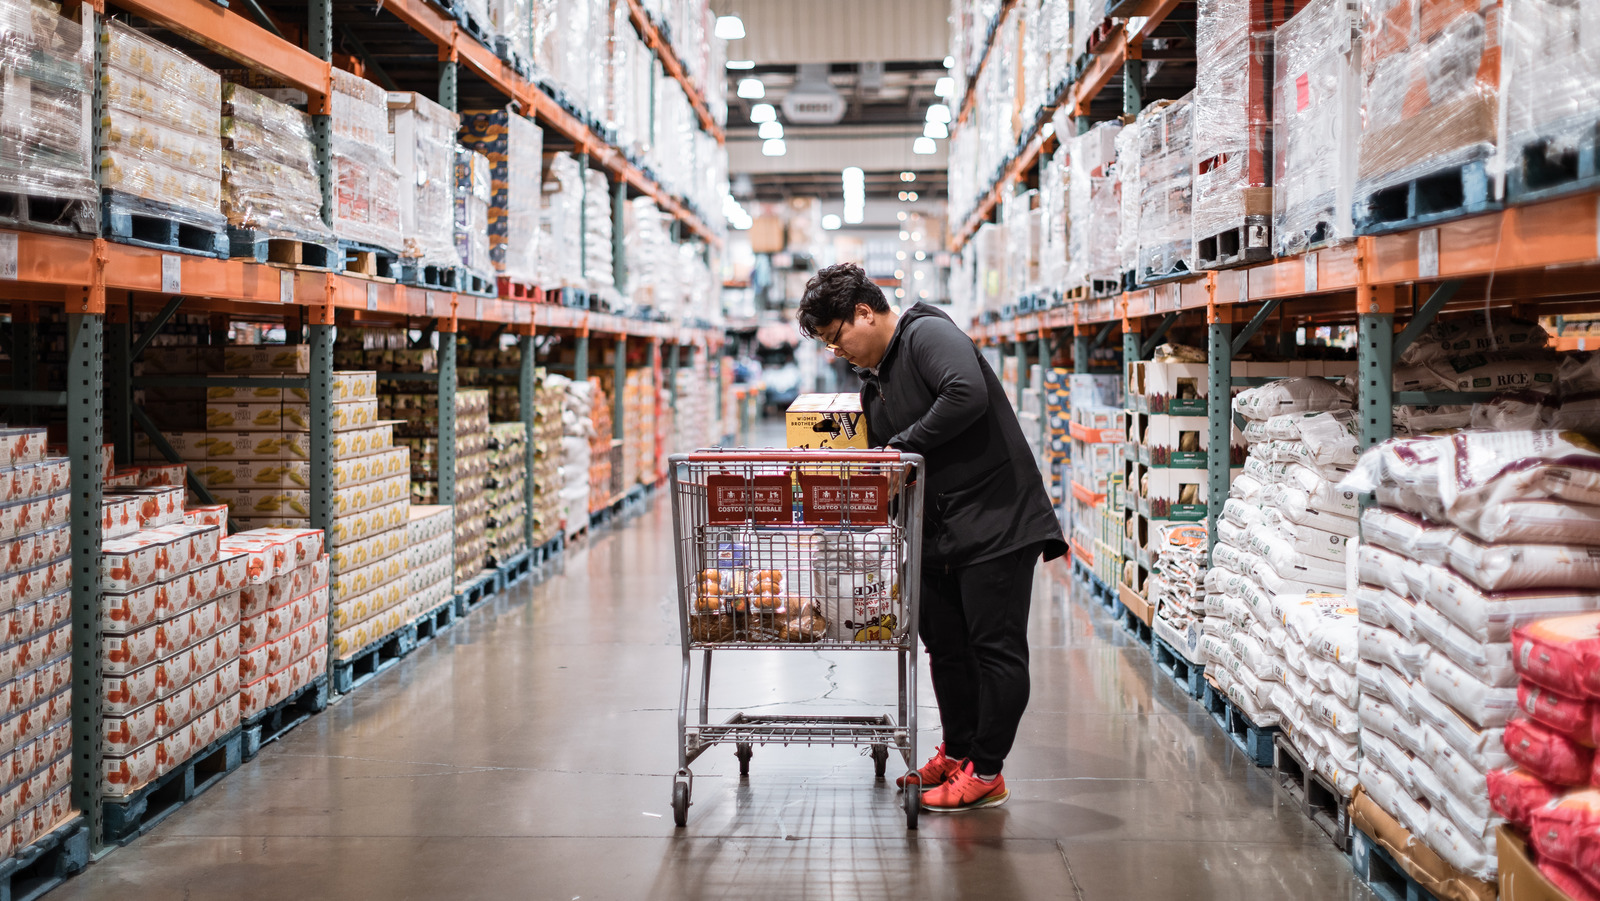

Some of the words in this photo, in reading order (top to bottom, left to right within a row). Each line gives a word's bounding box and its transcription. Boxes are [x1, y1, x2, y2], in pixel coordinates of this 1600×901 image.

[1476, 335, 1505, 349] RIE
[1497, 373, 1529, 386] RICE
[854, 581, 886, 596] RICE
